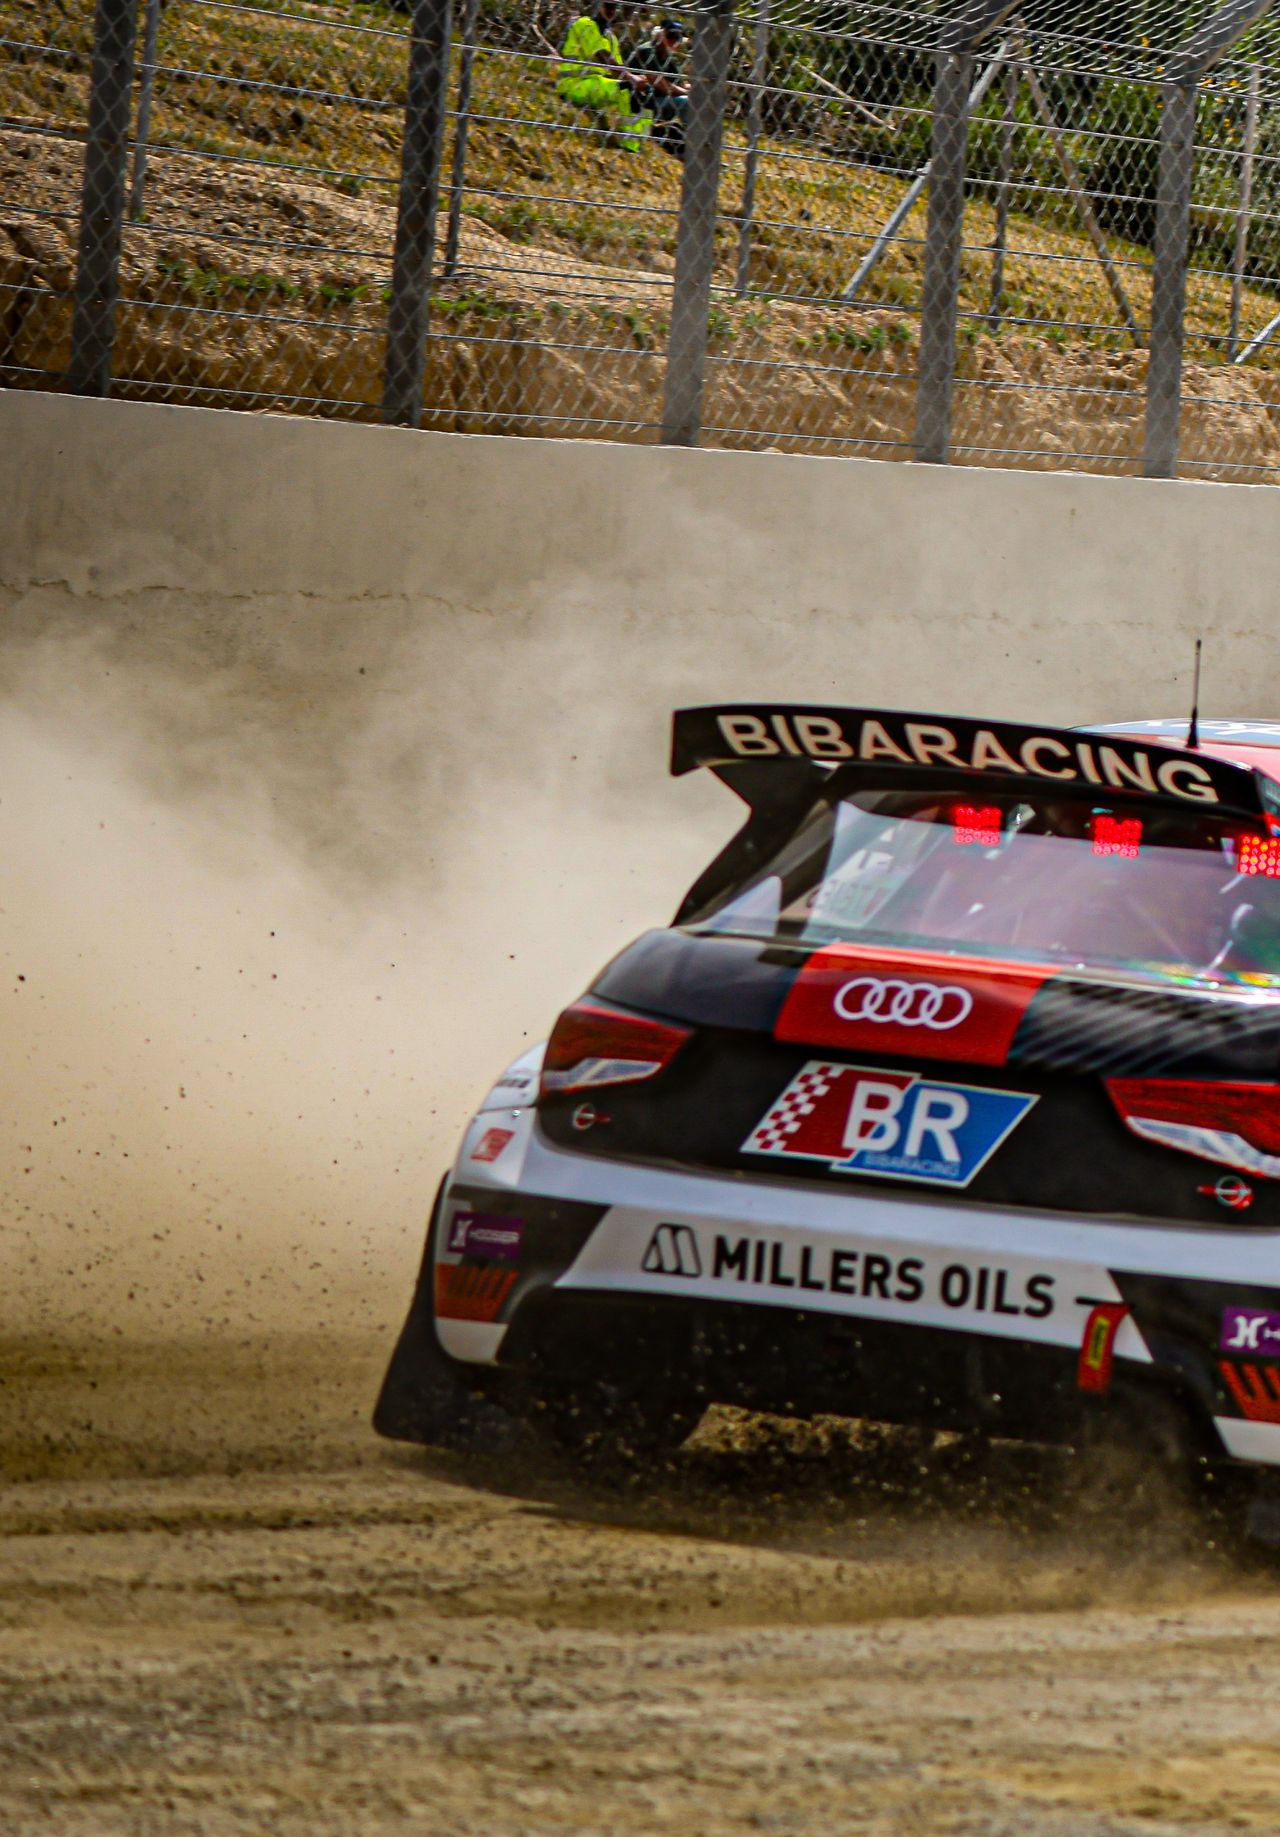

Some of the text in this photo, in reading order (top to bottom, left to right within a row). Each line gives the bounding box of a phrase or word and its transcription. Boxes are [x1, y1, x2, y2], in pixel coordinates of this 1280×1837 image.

[716, 714, 1219, 802] BIBARACING
[842, 1080, 969, 1162] BR
[864, 1154, 960, 1177] BIBARACING
[713, 1234, 1056, 1319] MILLERS OILS
